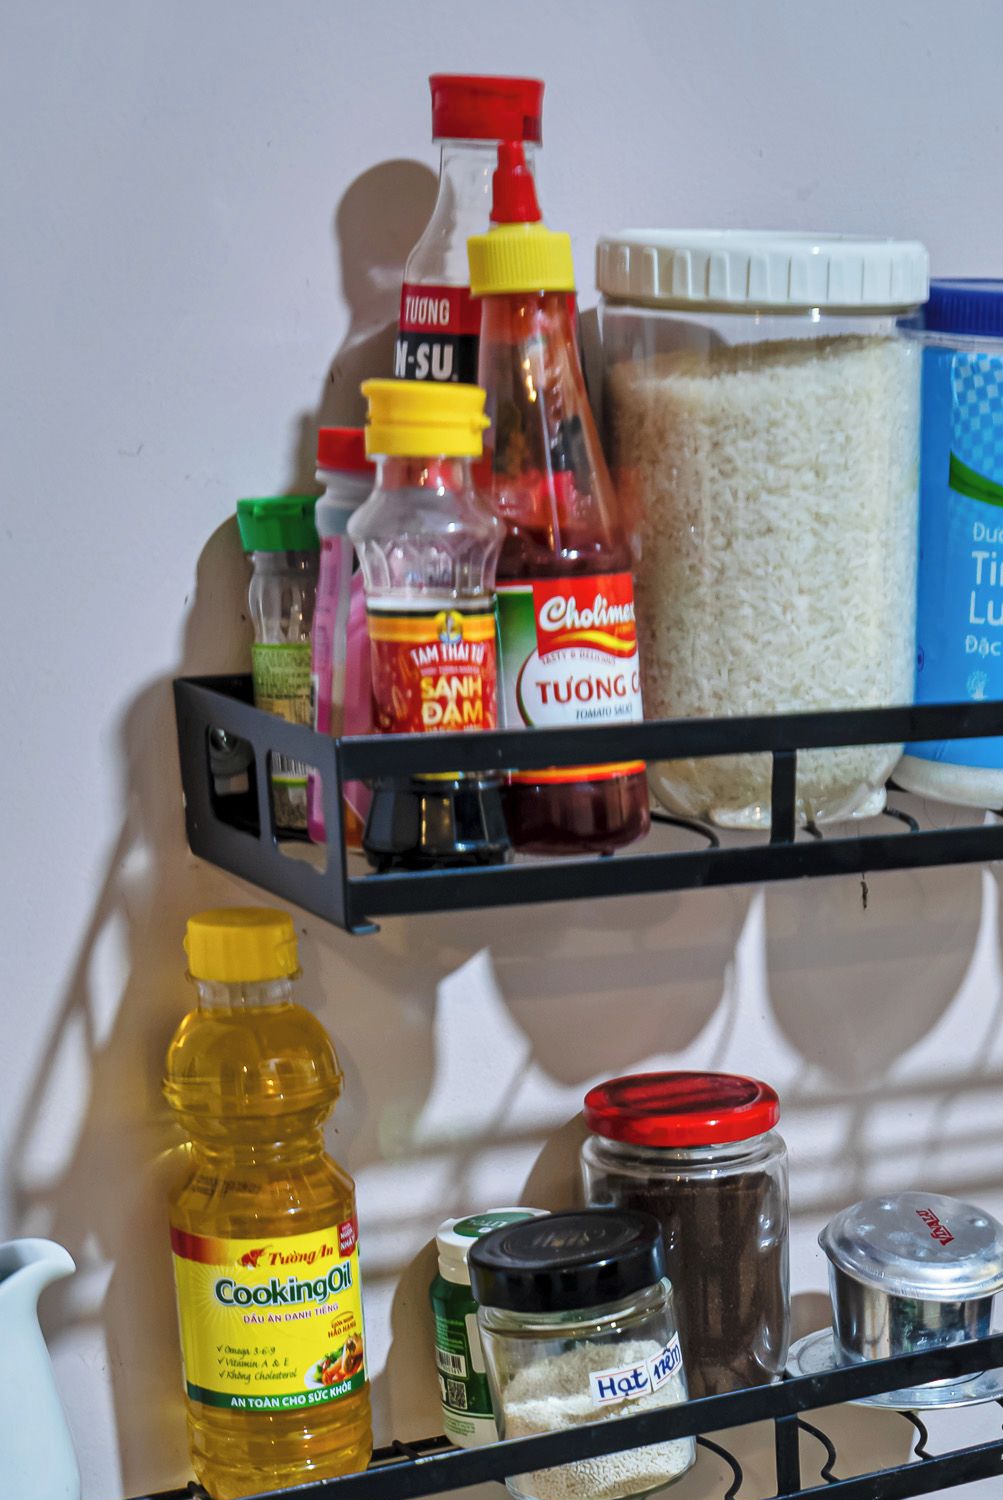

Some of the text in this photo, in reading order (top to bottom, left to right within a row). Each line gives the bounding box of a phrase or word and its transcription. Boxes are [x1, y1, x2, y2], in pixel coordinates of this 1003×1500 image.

[536, 674, 627, 704] TƯƠNG
[284, 1310, 312, 1322] DANH
[597, 1369, 648, 1397] Hạt
[230, 1397, 246, 1408] AN
[248, 1395, 280, 1408] TOÀN
[282, 1395, 307, 1407] CHO
